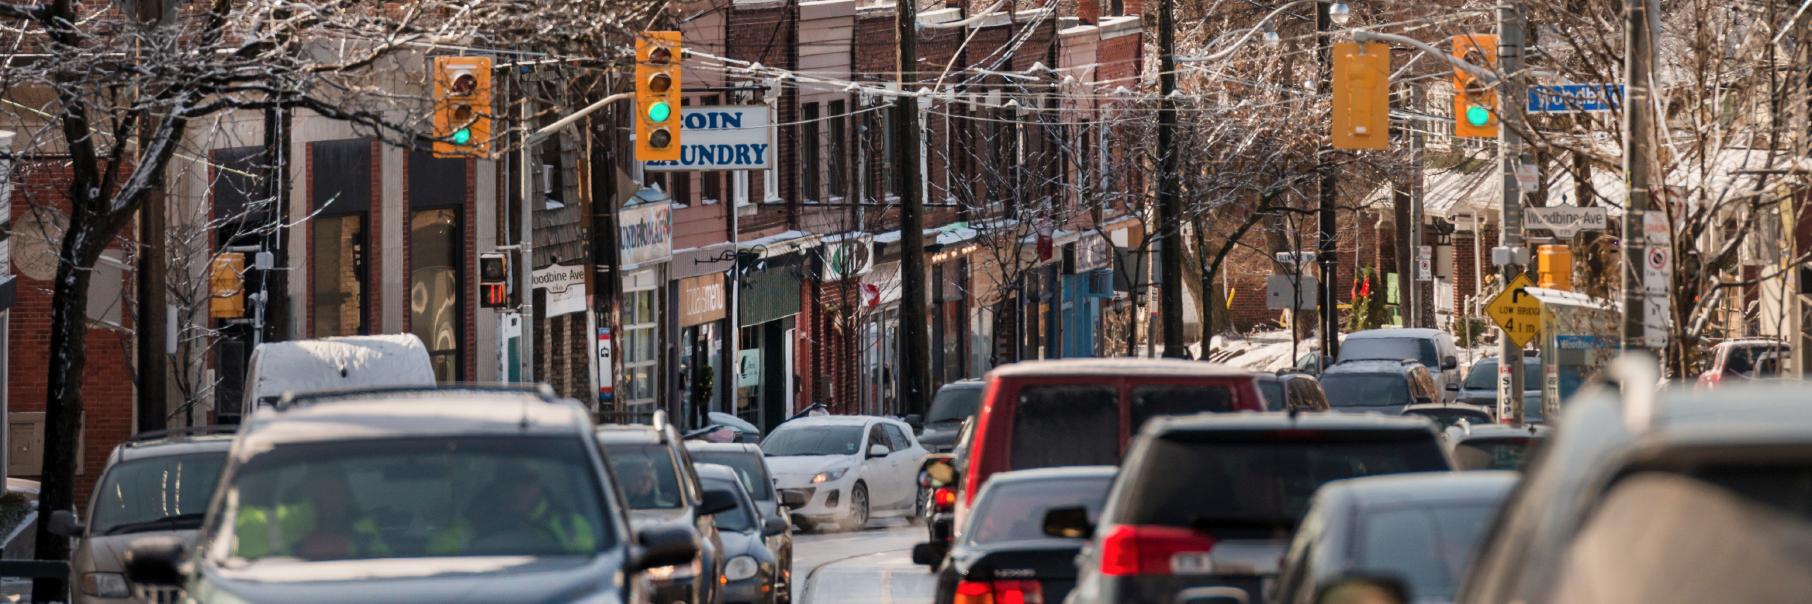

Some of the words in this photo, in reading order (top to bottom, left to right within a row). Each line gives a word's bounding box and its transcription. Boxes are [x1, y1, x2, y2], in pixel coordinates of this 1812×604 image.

[680, 112, 743, 129] OIN
[646, 143, 768, 166] UNDRY
[1584, 211, 1603, 225] Ave
[569, 269, 585, 281] Ave
